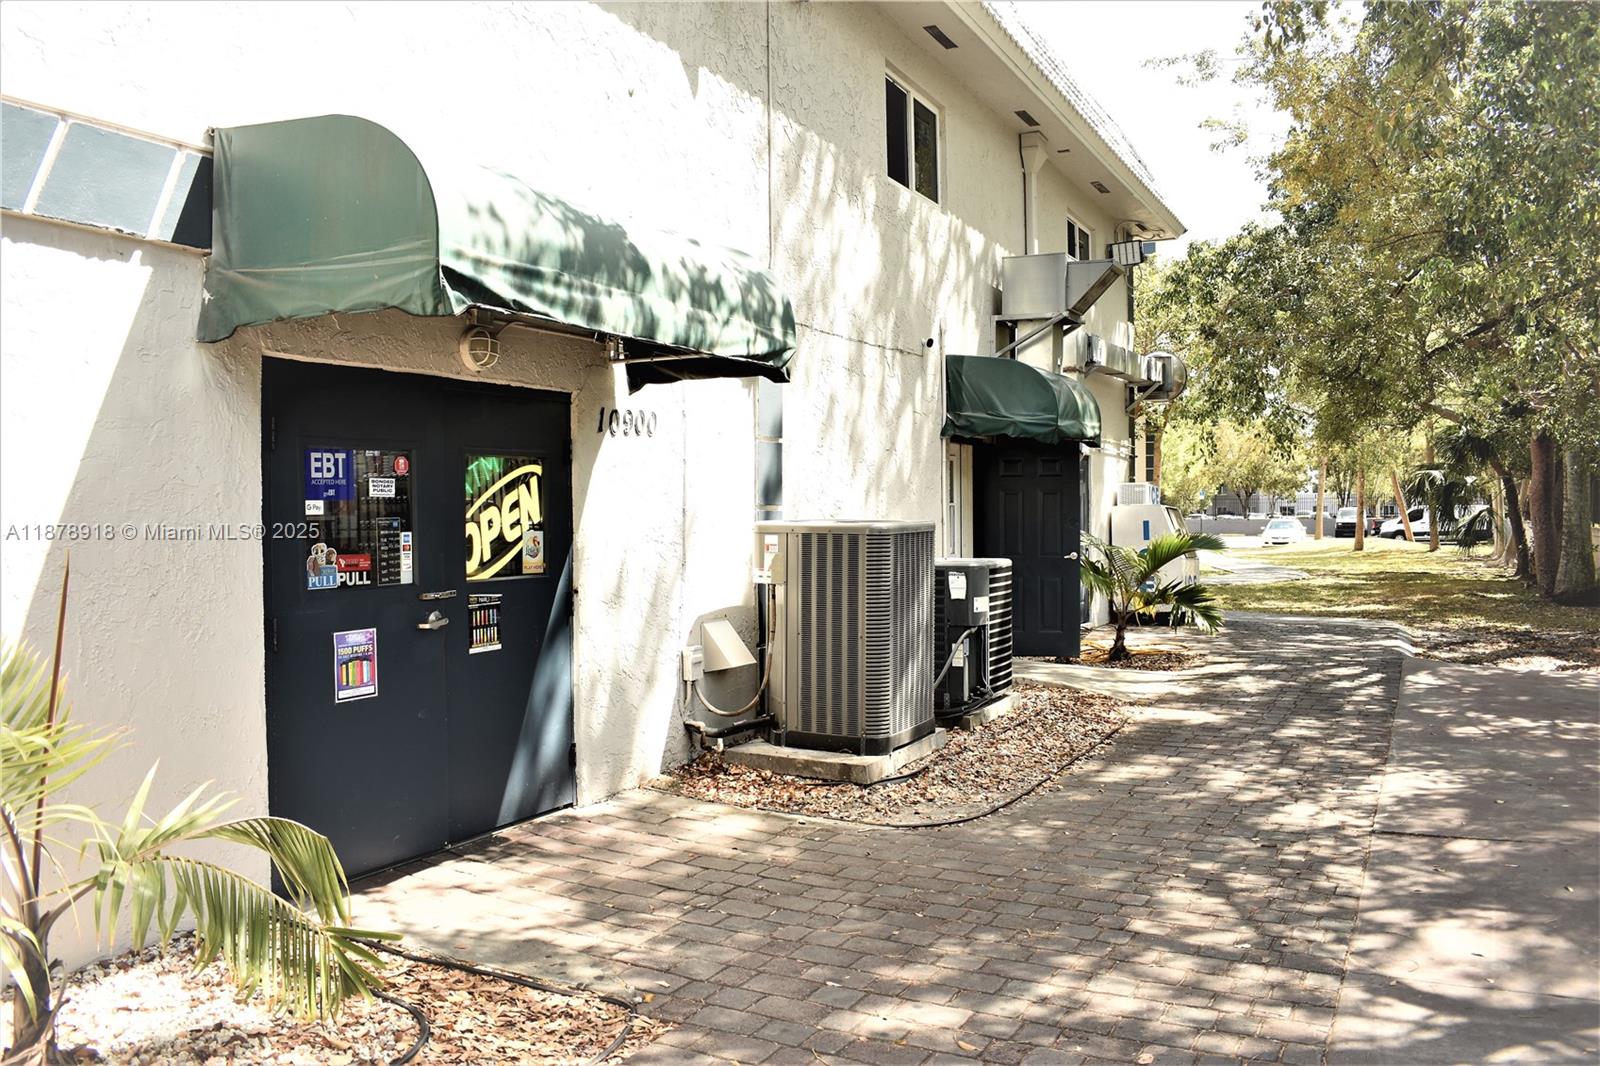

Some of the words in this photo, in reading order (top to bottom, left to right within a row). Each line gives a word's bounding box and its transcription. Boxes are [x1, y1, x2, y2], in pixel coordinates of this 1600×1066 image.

[597, 407, 657, 438] 10900
[311, 452, 346, 479] EBT
[466, 457, 500, 494] TM
[466, 475, 541, 575] OPEN
[308, 576, 337, 587] PULL
[338, 571, 371, 586] PULL
[352, 644, 374, 653] PUFFS
